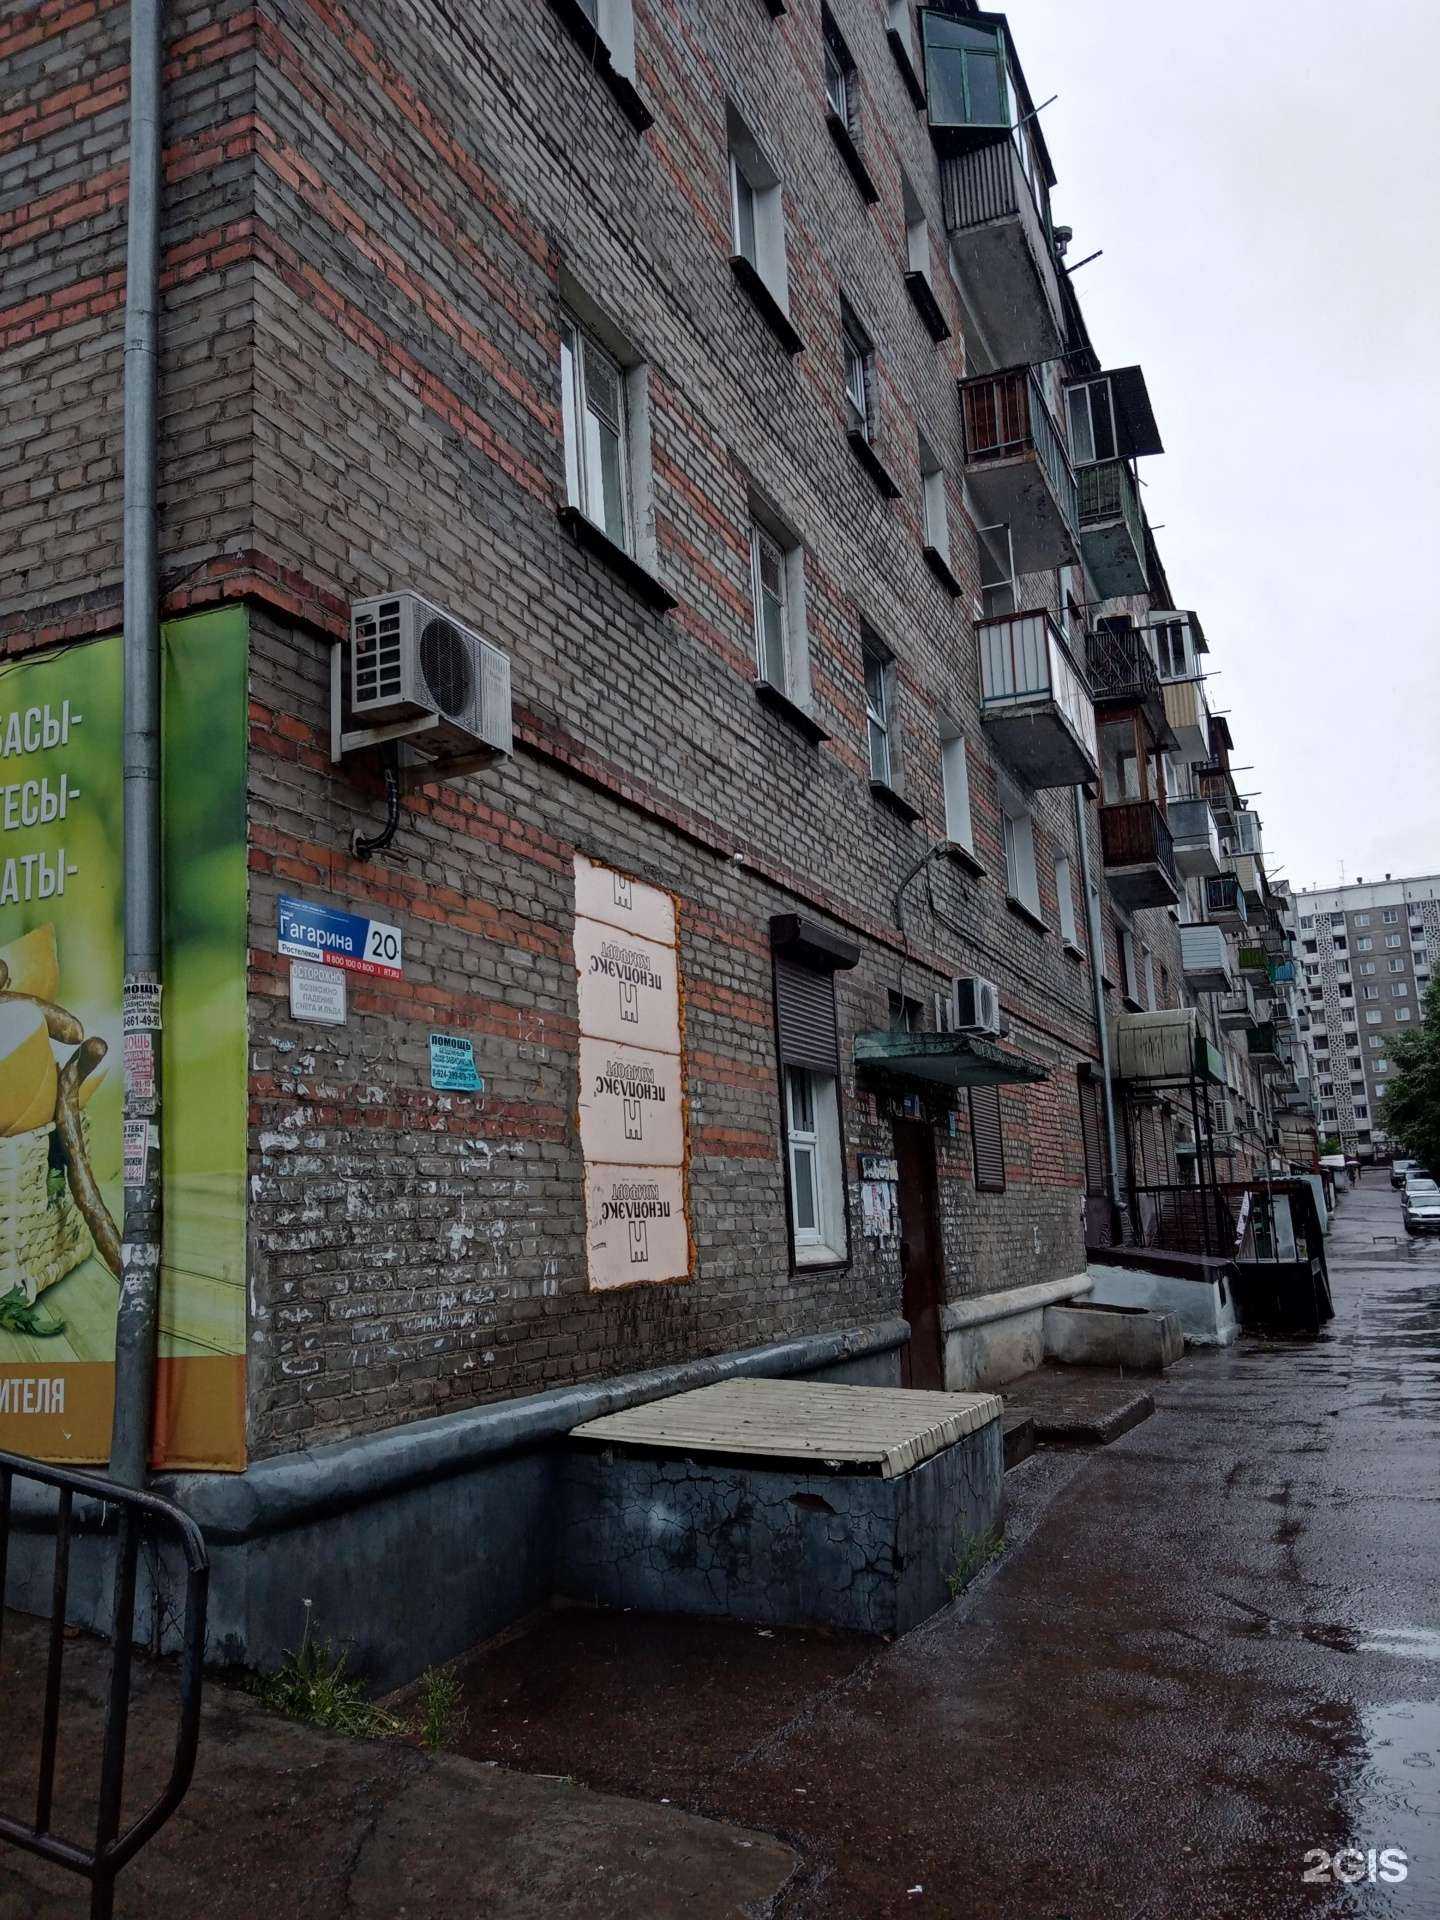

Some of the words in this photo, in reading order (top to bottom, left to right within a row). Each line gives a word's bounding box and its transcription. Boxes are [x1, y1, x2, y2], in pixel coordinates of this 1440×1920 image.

[280, 915, 353, 952] Гагарина
[372, 930, 398, 961] 20
[282, 943, 320, 960] Ростелеком
[331, 955, 344, 966] 800
[345, 958, 356, 969] 100
[431, 1035, 471, 1051] ПОМОЩЬ
[606, 1060, 655, 1084] КОМФОРТ
[595, 1076, 665, 1102] ПЕНОПЛЭКС
[601, 1201, 670, 1220] ПЕНОПЛЭКС
